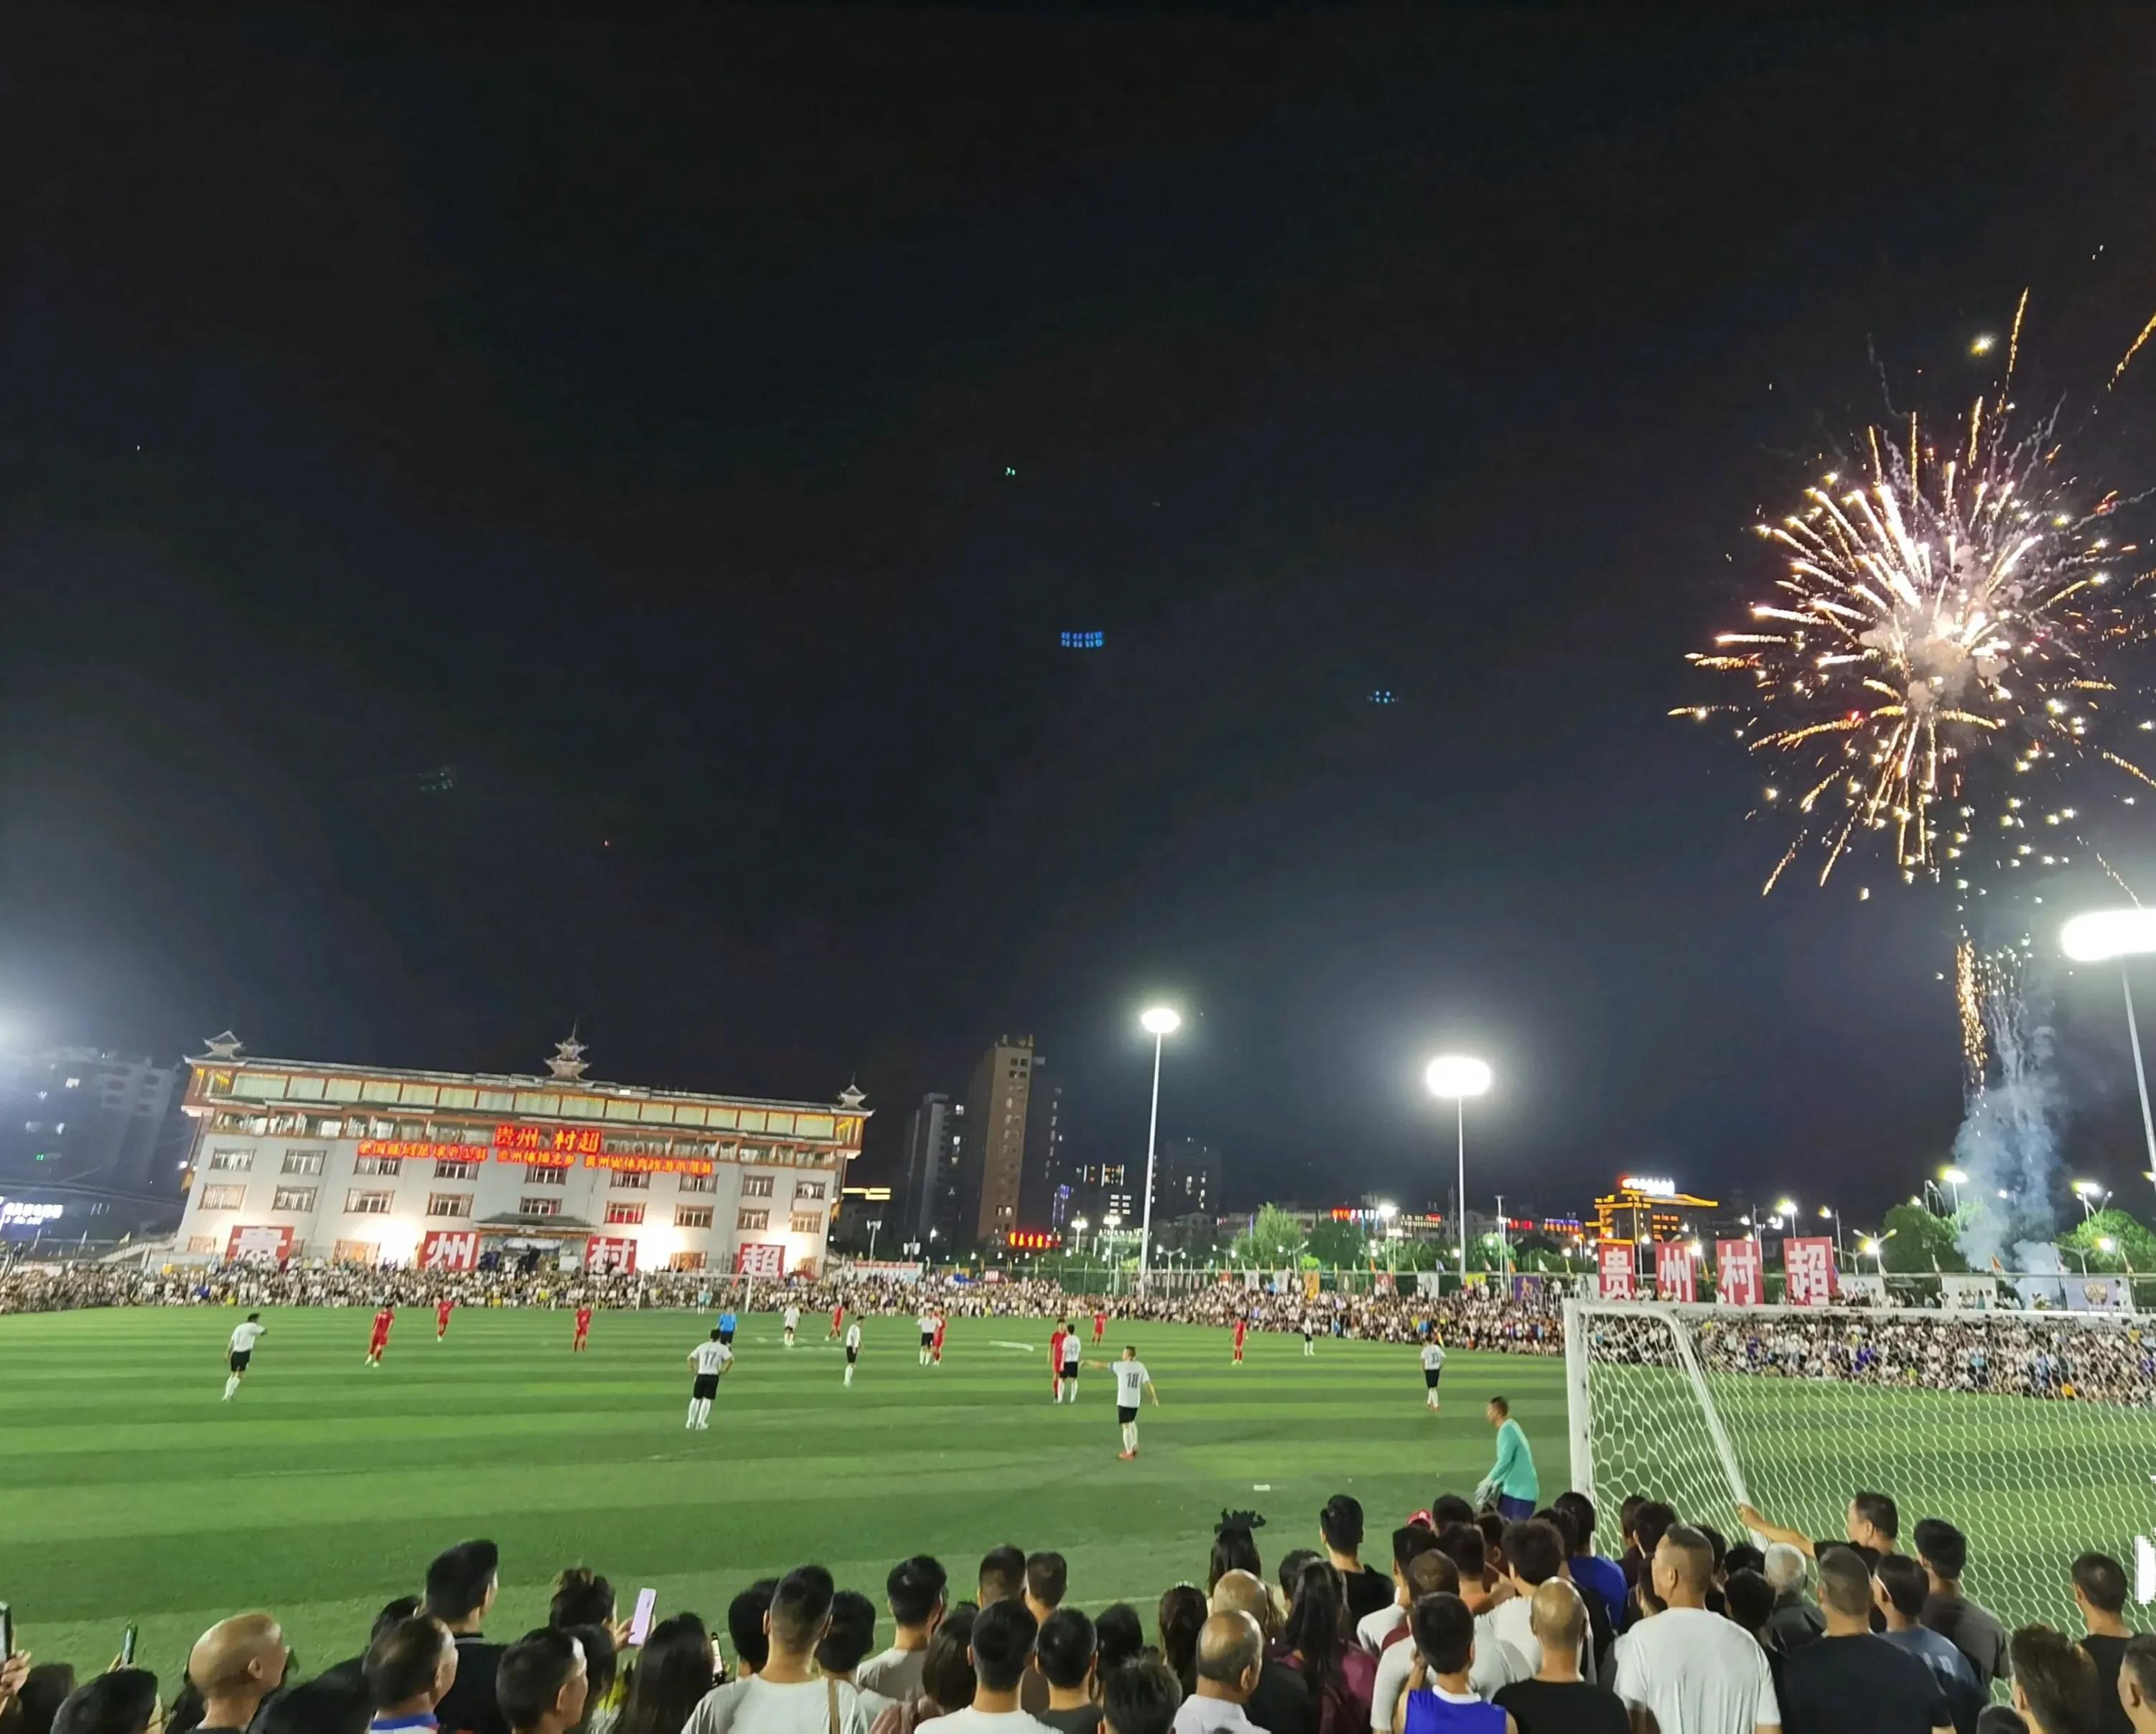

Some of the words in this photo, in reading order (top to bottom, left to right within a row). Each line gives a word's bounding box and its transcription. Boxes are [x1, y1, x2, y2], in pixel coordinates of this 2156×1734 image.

[496, 1125, 538, 1148] 贵州
[554, 1129, 600, 1152] 村超
[425, 1233, 475, 1270] 州
[589, 1237, 635, 1274] 村
[739, 1244, 781, 1279] 超
[1601, 1247, 1632, 1300] 贵
[1661, 1246, 1693, 1302] 州
[1721, 1244, 1757, 1304] 村
[1788, 1242, 1829, 1305] 超
[704, 1350, 717, 1366] 17
